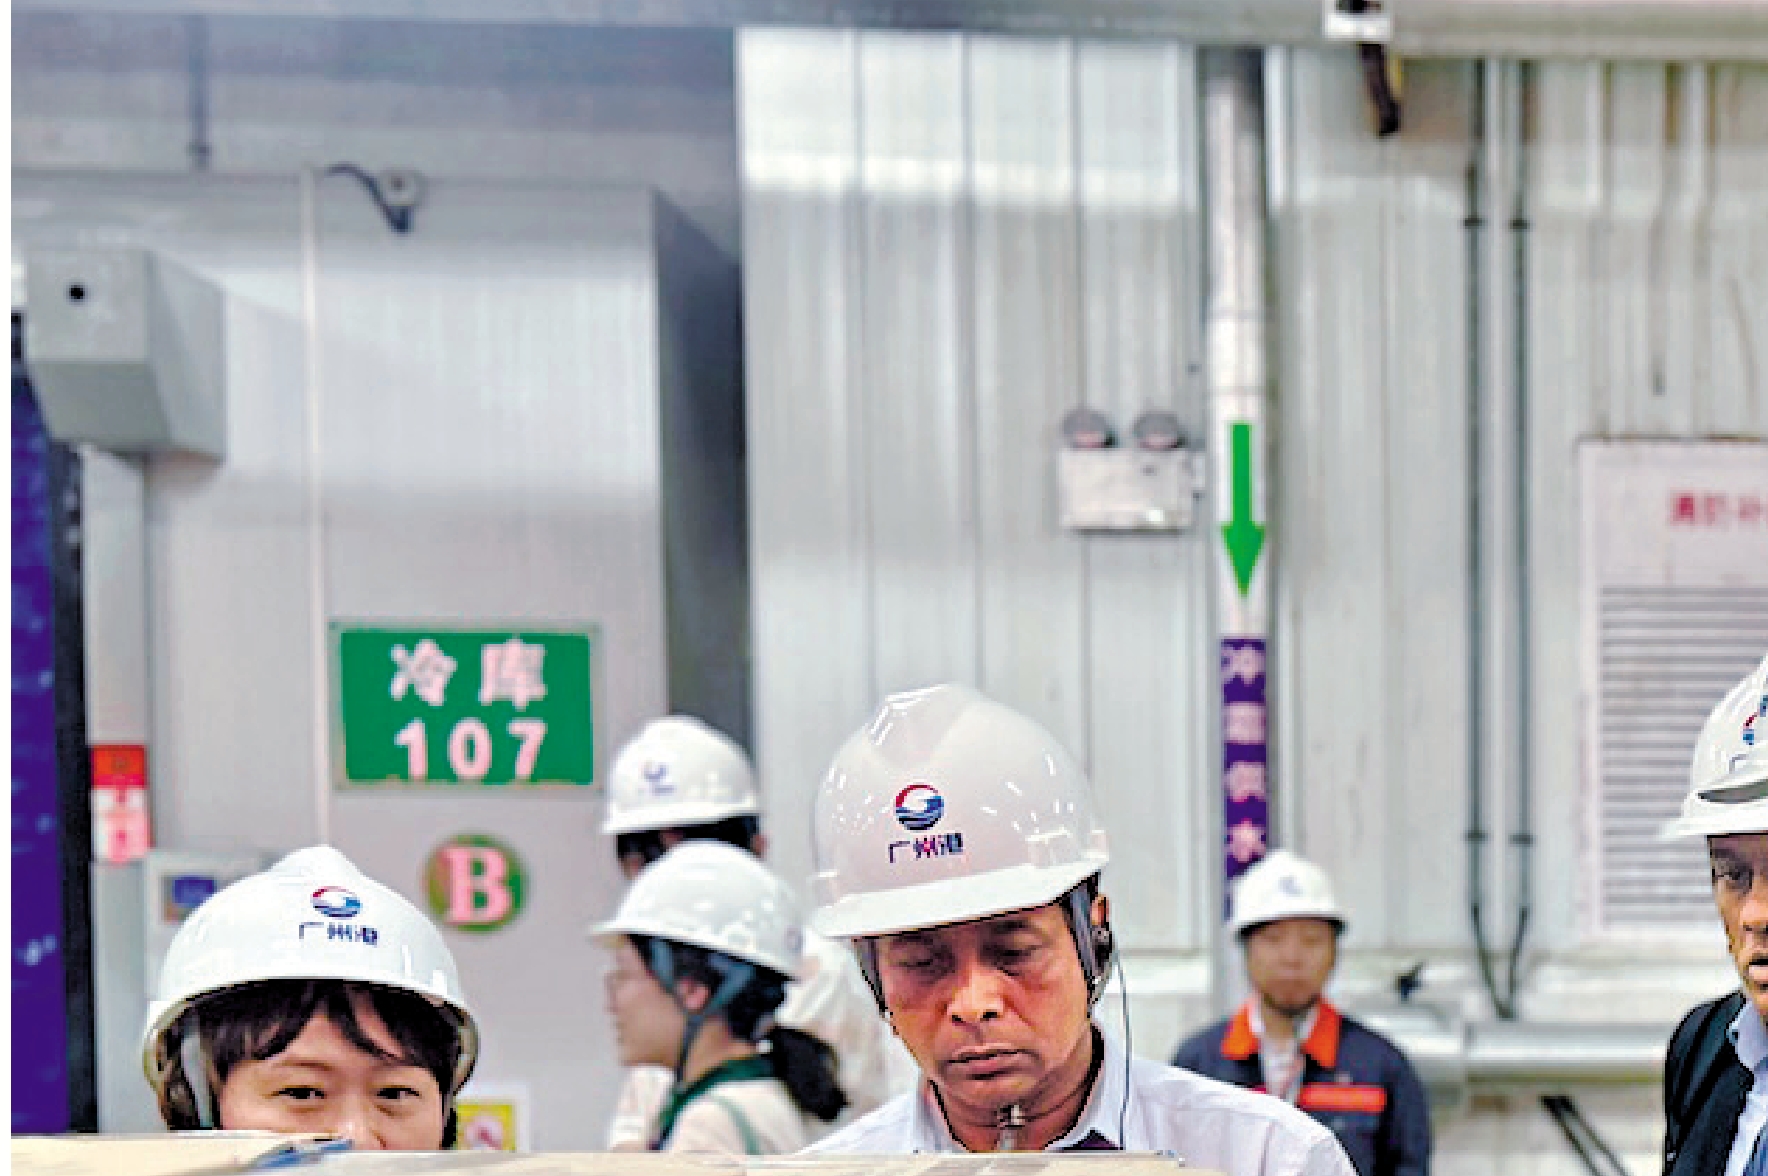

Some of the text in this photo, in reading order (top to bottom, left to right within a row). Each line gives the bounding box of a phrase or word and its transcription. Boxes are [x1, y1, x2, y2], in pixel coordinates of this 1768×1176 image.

[390, 638, 548, 709] 冷库
[394, 718, 548, 779] 107
[443, 846, 512, 924] B
